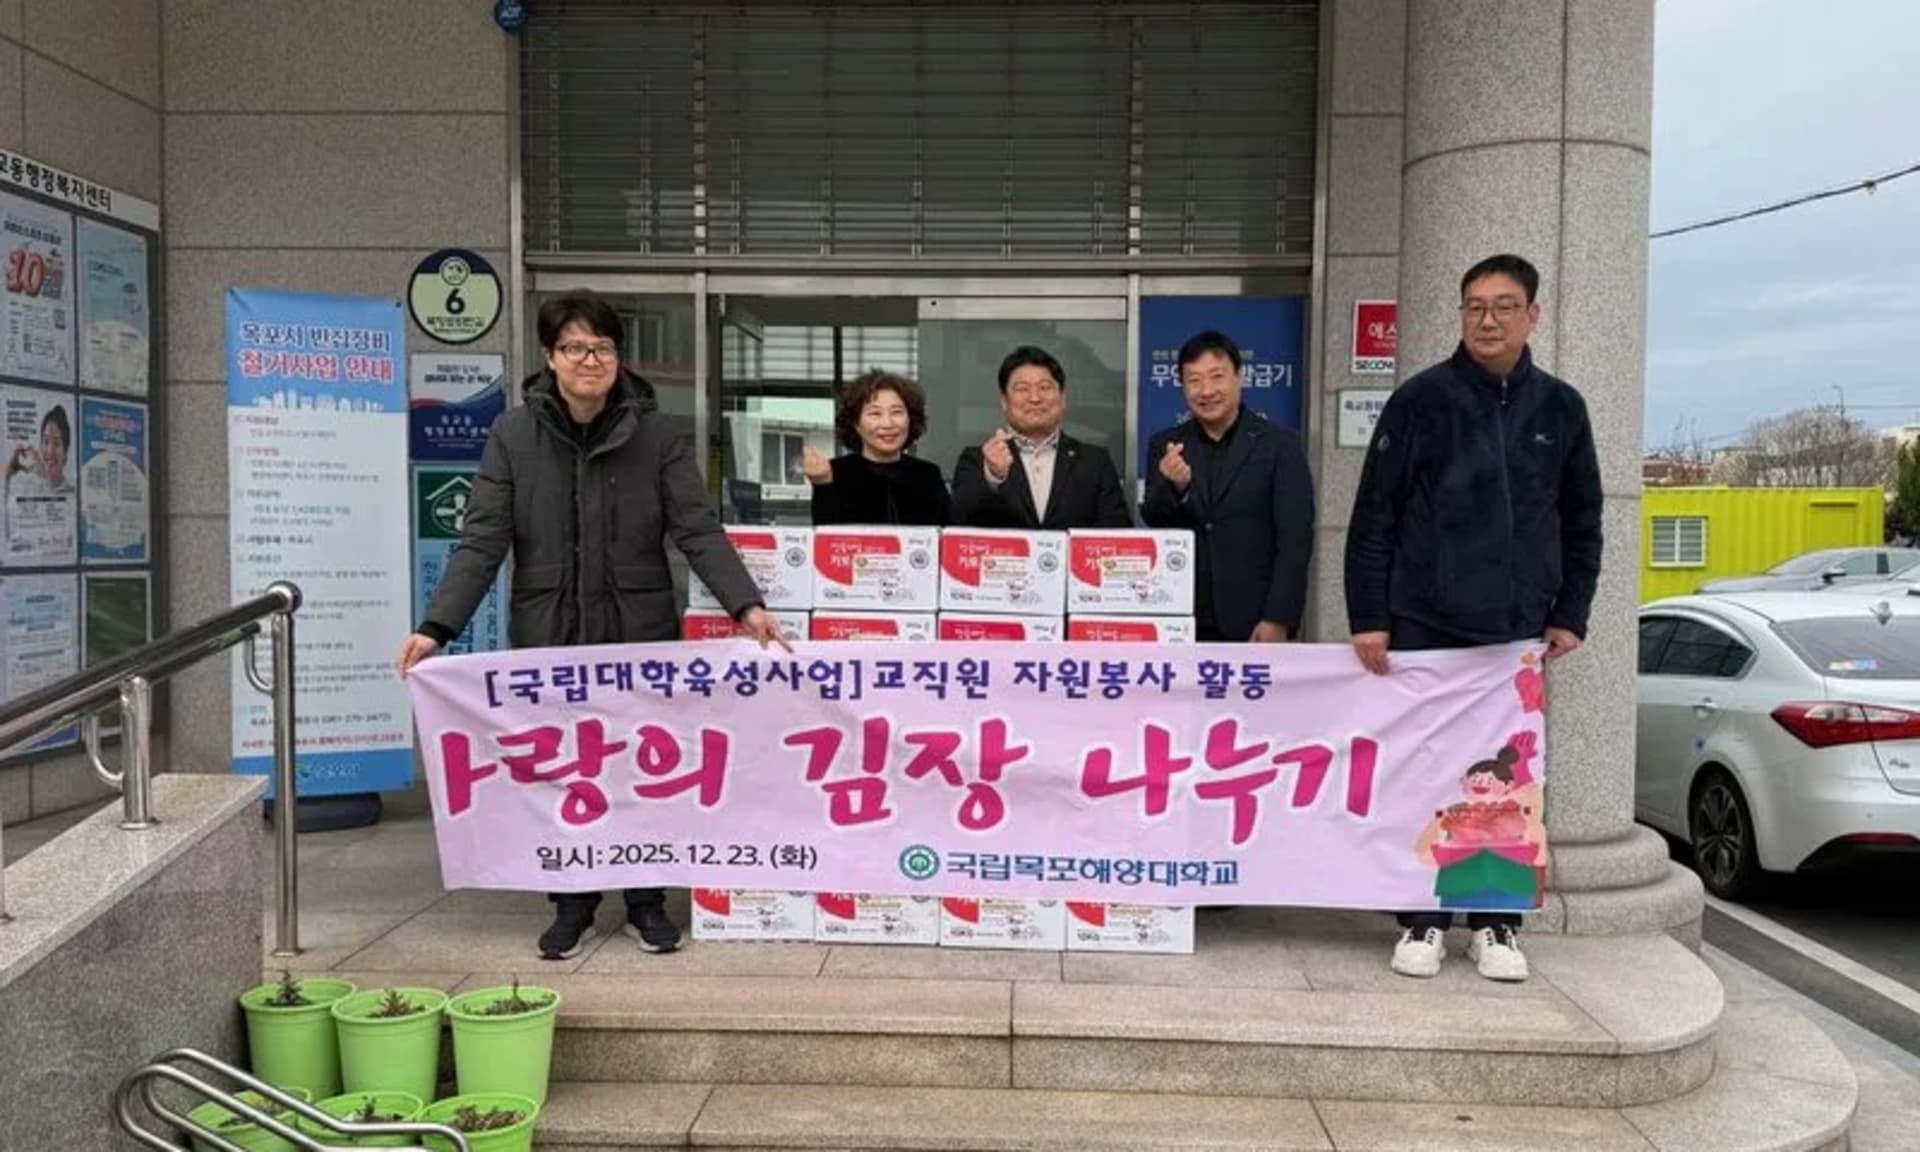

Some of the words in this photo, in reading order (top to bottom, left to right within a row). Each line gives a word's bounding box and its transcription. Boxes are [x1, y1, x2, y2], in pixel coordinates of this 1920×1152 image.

[445, 287, 466, 315] 6
[243, 321, 304, 346] 목포시
[242, 350, 338, 379] 철거사업
[346, 355, 393, 382] 안내
[1013, 658, 1176, 700] 자원봉사
[1196, 659, 1273, 700] 활동
[783, 716, 1028, 831] 김장
[1080, 718, 1378, 845] 나누기
[608, 843, 680, 865] 2025.
[687, 843, 721, 866] 12.
[726, 844, 764, 867] 23.
[769, 844, 818, 871] (화)
[946, 851, 1240, 887] 국립목포해양대학교
